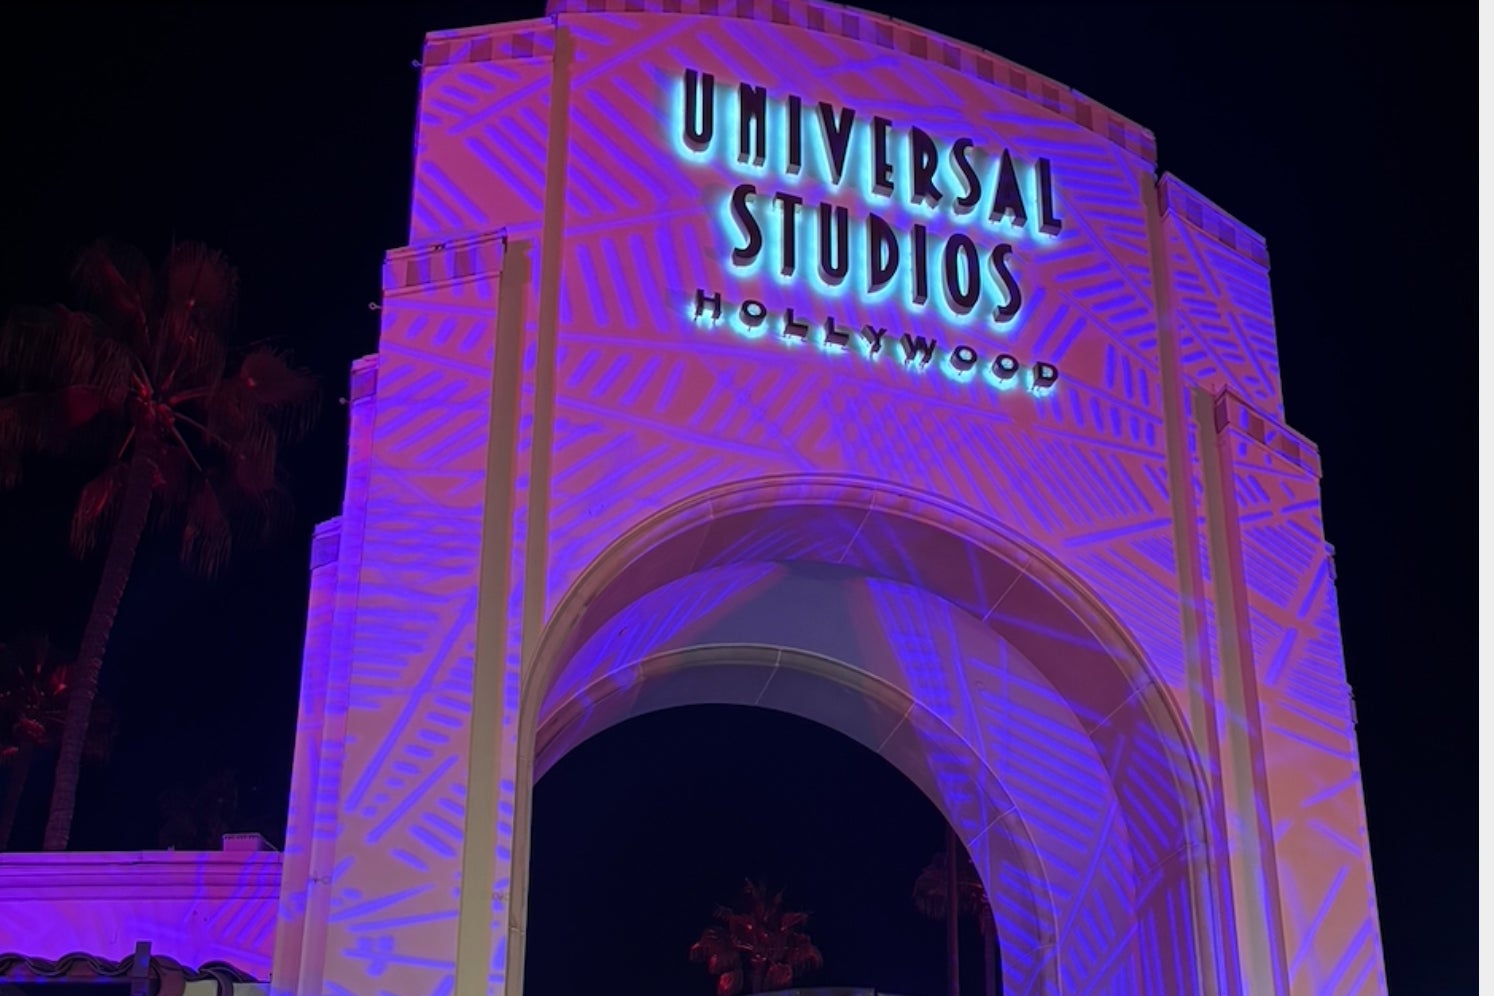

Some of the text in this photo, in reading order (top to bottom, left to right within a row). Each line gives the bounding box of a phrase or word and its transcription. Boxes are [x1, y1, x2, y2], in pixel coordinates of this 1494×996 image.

[682, 67, 1063, 237] UNIVERSAL
[729, 183, 1024, 325] STUDIOS
[692, 287, 1060, 392] HOLLYWOOD
